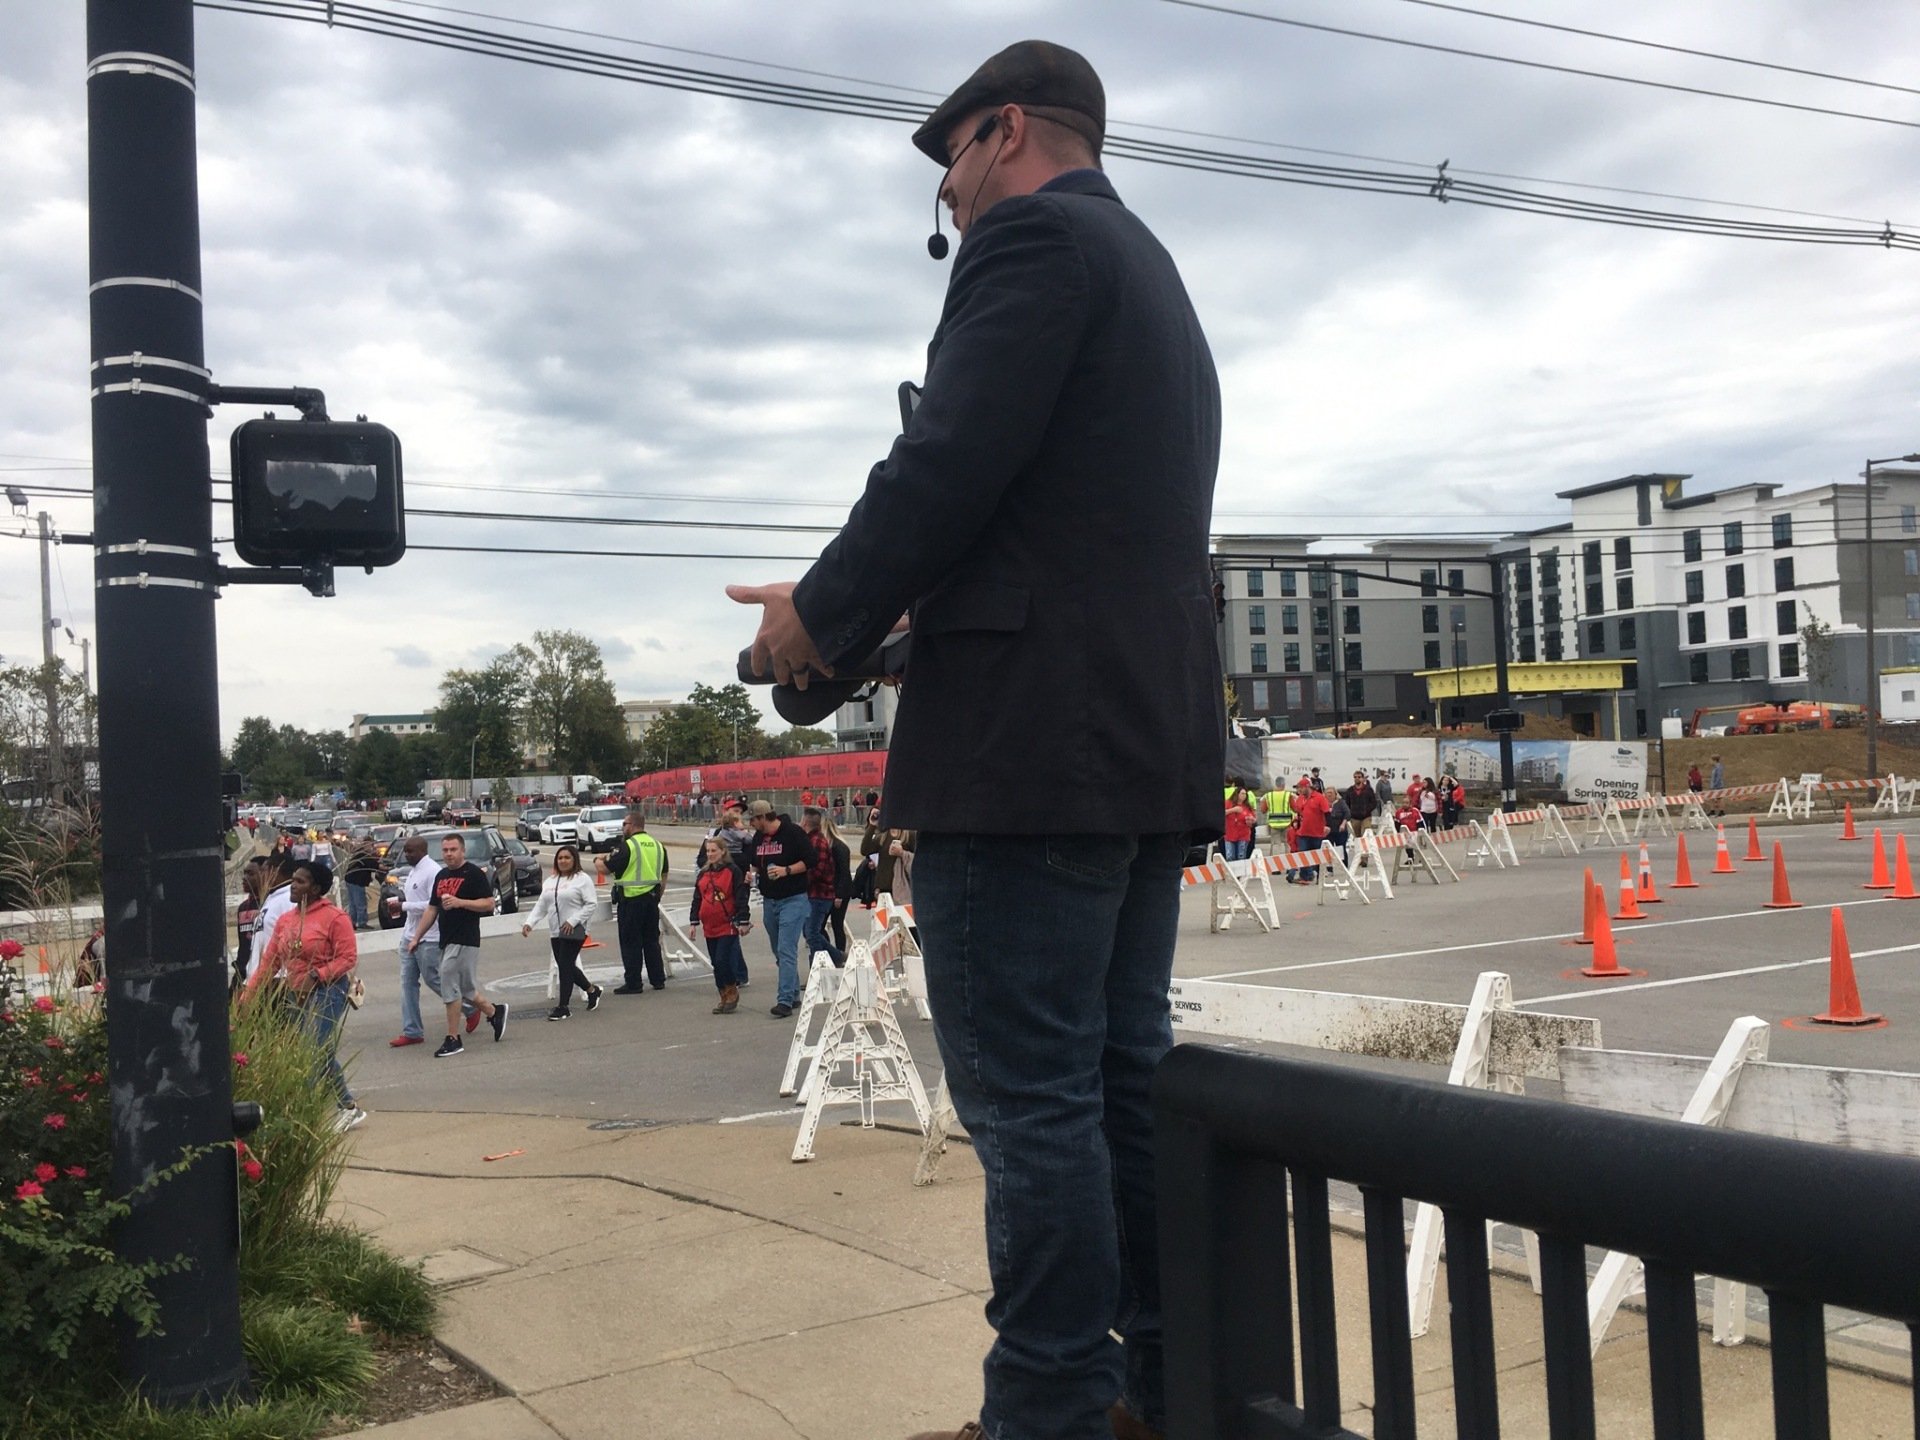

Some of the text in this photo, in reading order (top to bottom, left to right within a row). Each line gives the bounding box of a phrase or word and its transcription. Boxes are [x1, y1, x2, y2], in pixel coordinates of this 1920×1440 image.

[1594, 778, 1639, 790] Opening
[1574, 788, 1638, 799] Spring 2022
[1175, 1001, 1202, 1012] SERVICES
